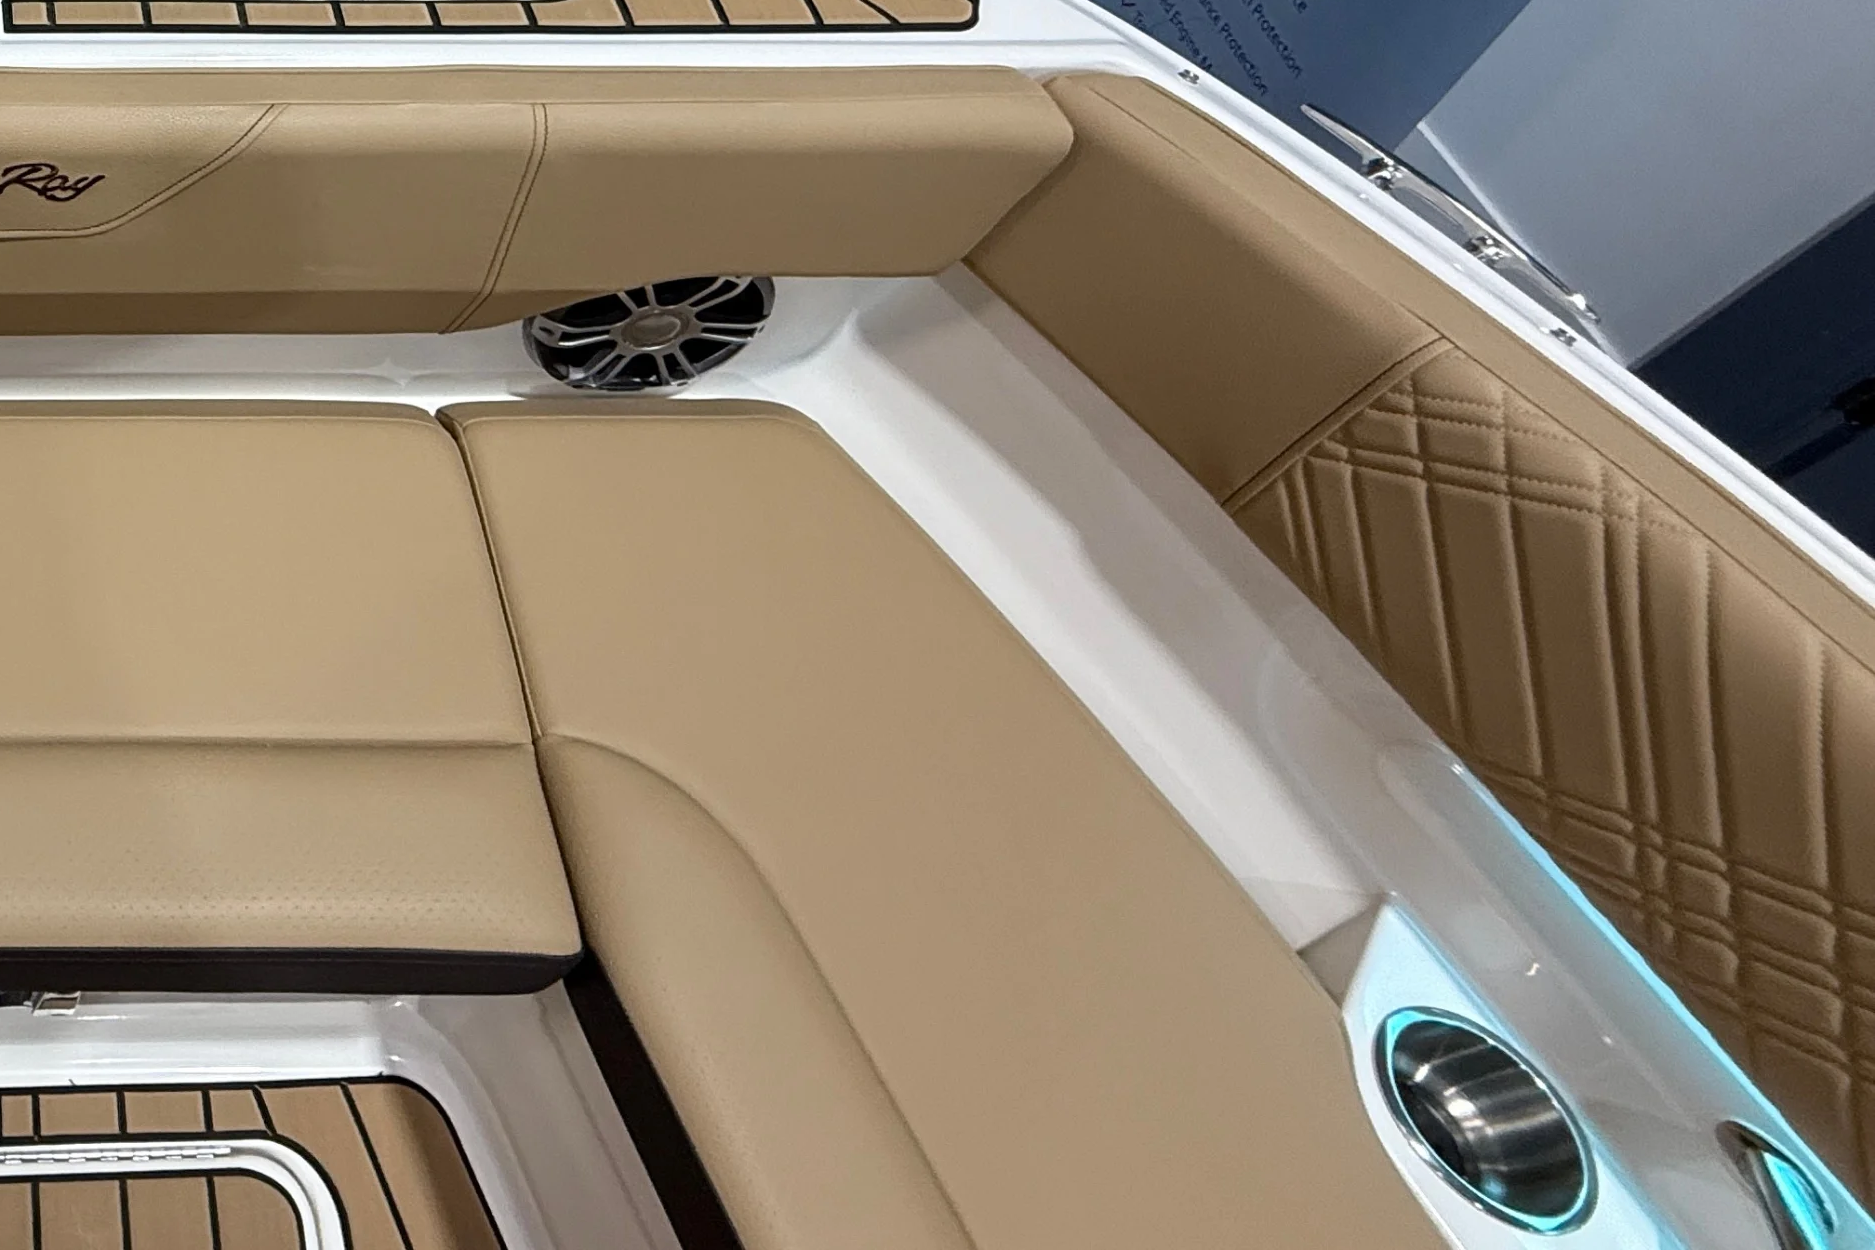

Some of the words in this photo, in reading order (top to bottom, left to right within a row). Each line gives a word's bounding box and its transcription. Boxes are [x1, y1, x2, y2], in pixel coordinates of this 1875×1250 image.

[1169, 10, 1200, 58] Engine
[1219, 23, 1268, 96] Protection
[1252, 3, 1303, 78] Protection
